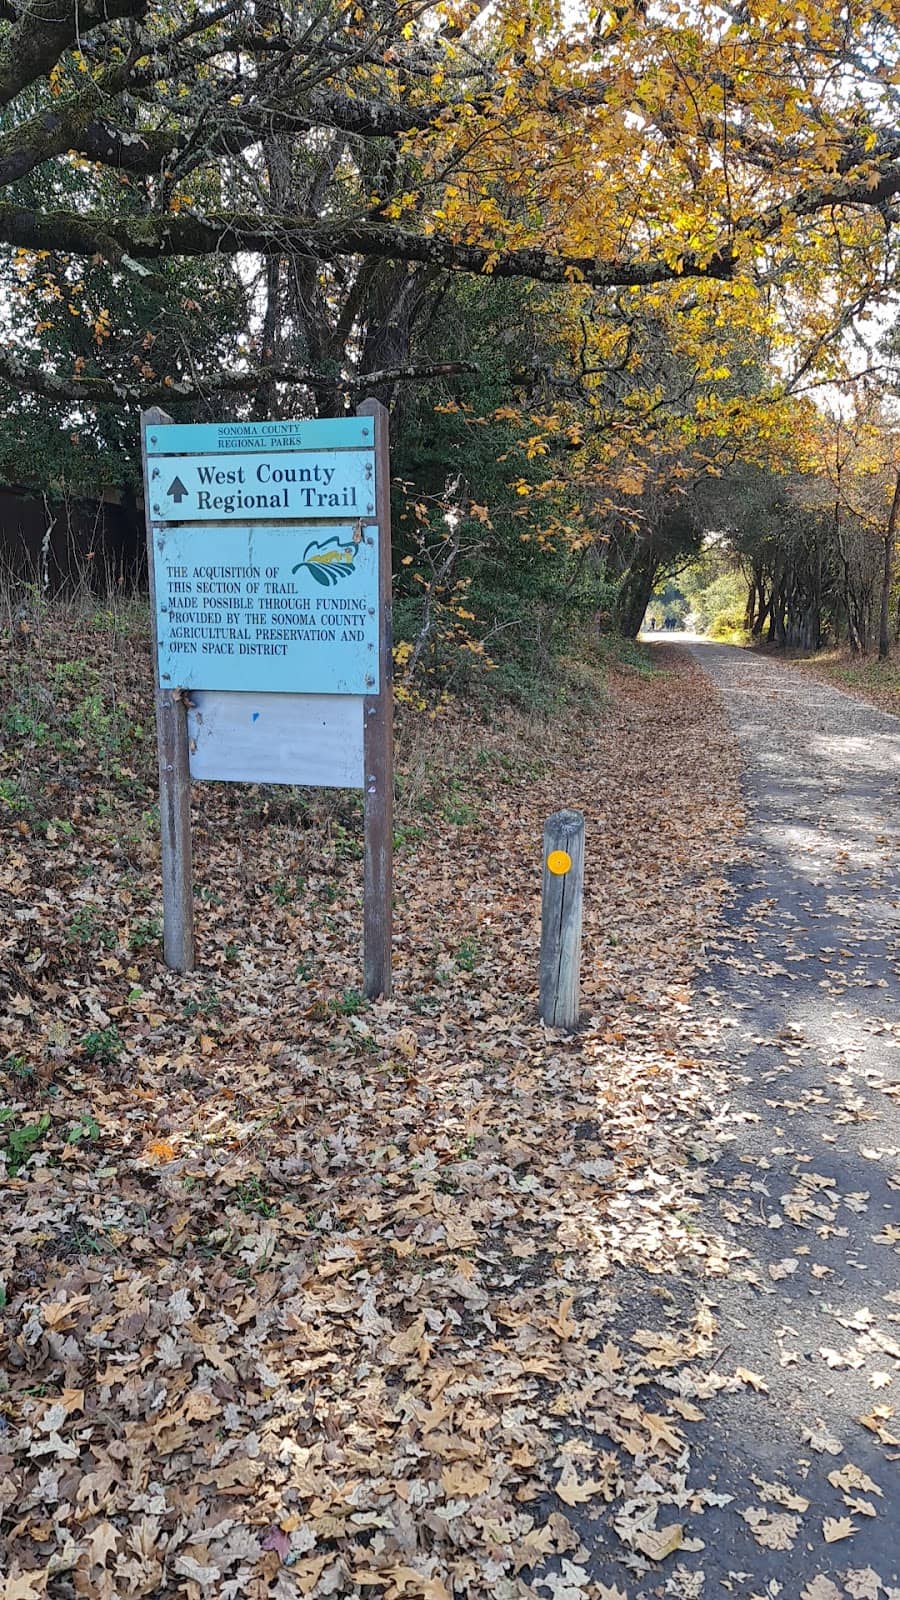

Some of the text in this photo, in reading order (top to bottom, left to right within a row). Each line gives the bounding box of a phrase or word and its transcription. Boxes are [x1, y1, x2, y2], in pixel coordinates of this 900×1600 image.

[218, 424, 300, 436] SONOMA COUNTY
[218, 437, 302, 449] REGIONAL PARKS
[197, 464, 335, 485] West County
[197, 487, 357, 514] Regional Trail
[167, 567, 279, 580] THE ACQUISITION OF
[167, 582, 298, 594] THIS SECTION OF TRAIL
[168, 597, 367, 611] MADE POSSIBLE THROUGH FUNDING
[168, 612, 366, 626] PROVIDED BY THE SONOMA COUNTY
[169, 627, 364, 642] AGRICULTURAL PRESERVATION AND
[169, 642, 288, 656] OPEN SPACE DISTRICT
